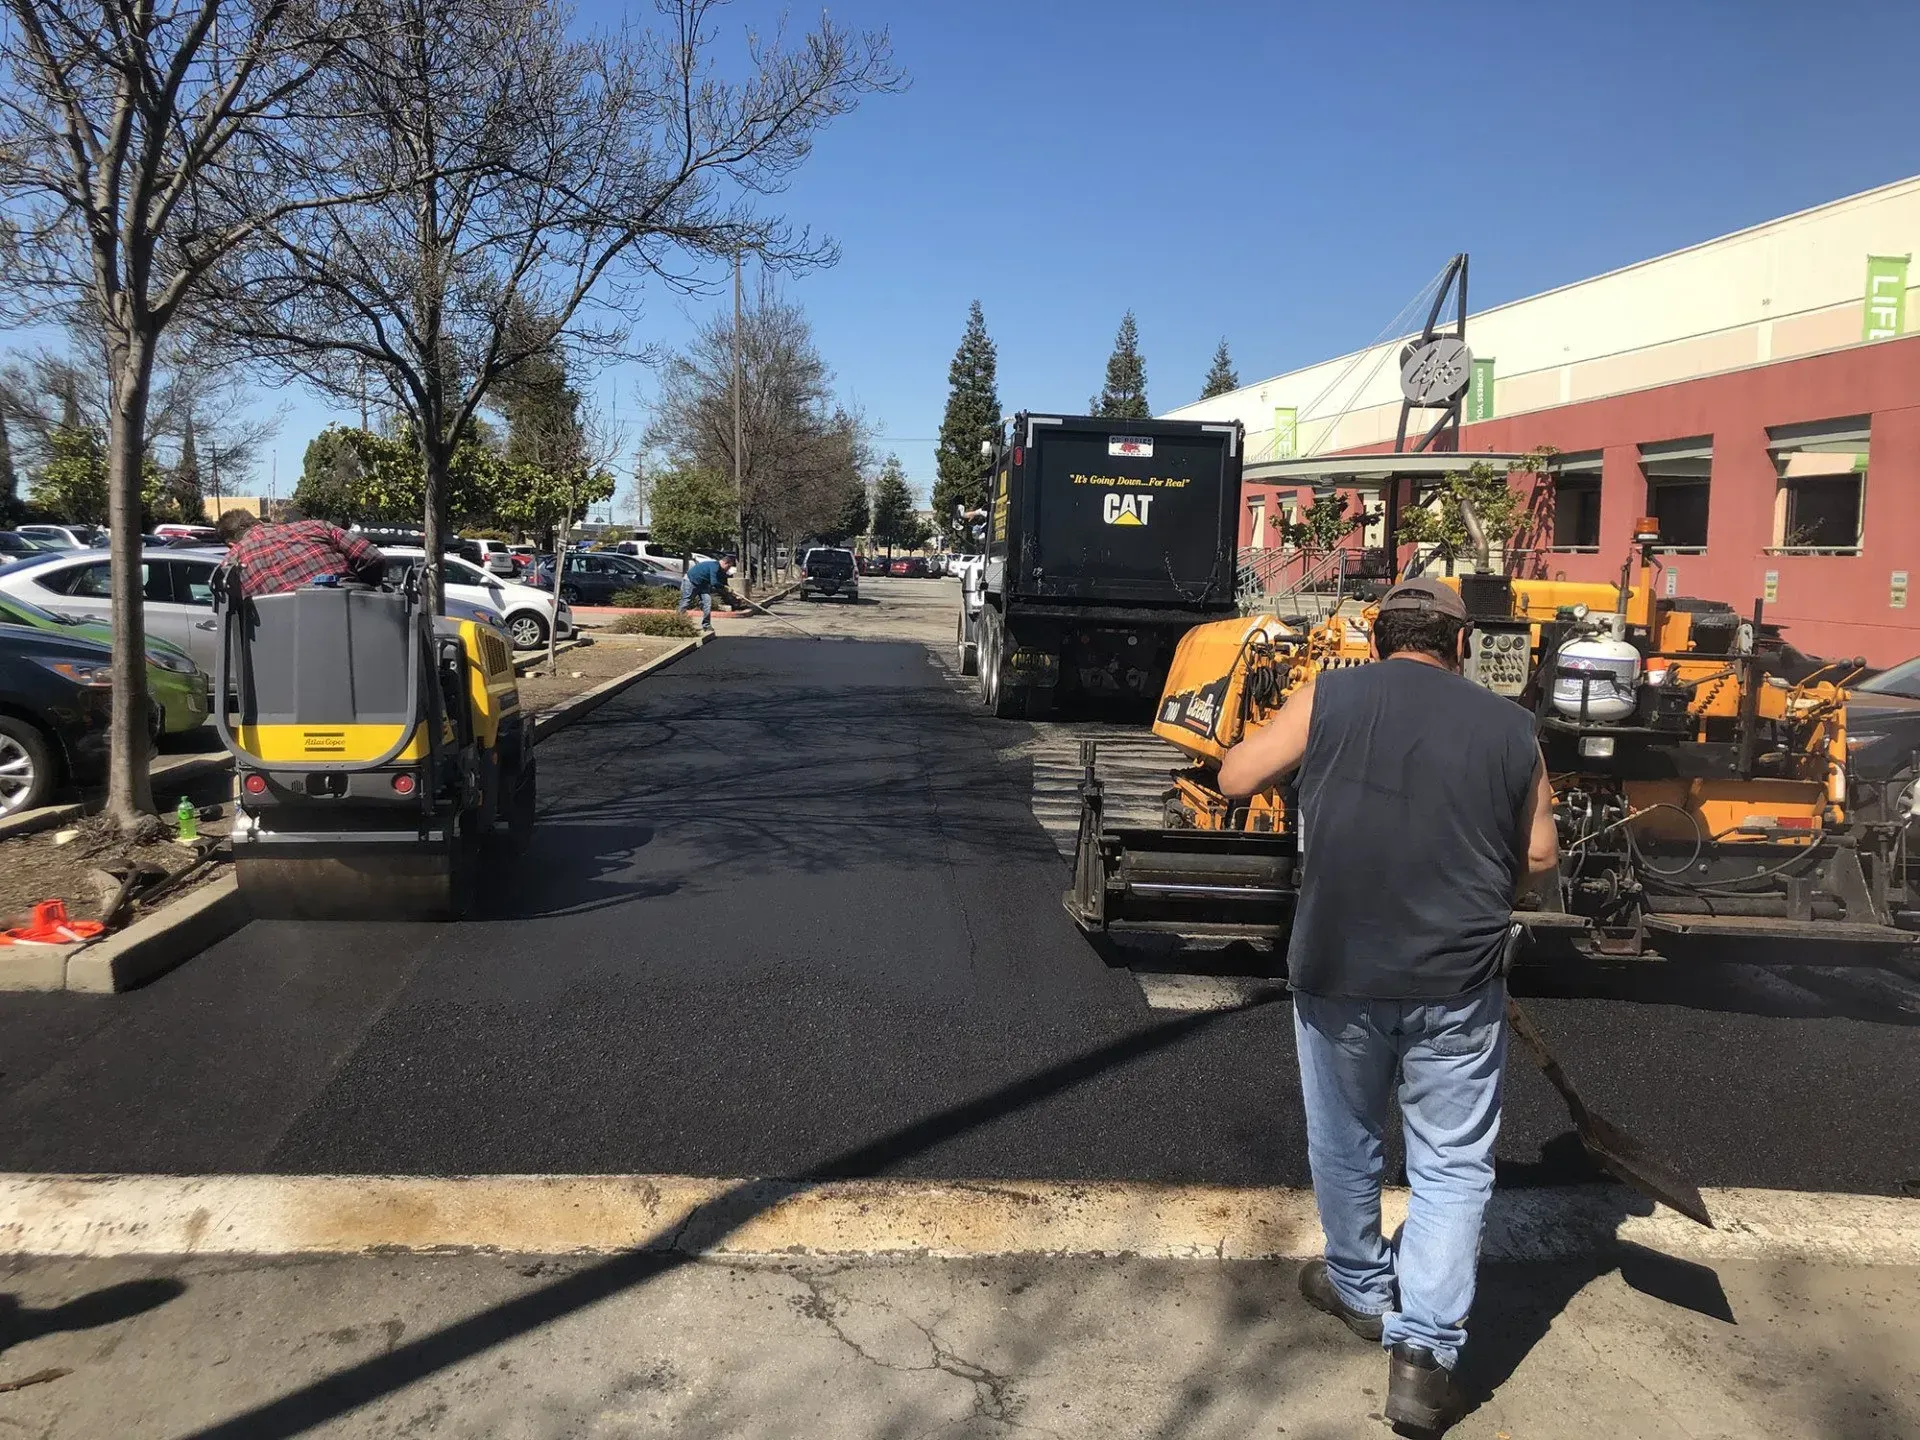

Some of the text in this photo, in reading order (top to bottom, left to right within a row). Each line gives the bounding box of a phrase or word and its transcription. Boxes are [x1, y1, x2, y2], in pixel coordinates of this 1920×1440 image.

[1090, 475, 1115, 486] Going
[1103, 493, 1154, 526] CAT
[304, 738, 346, 747] Atlas Copco
